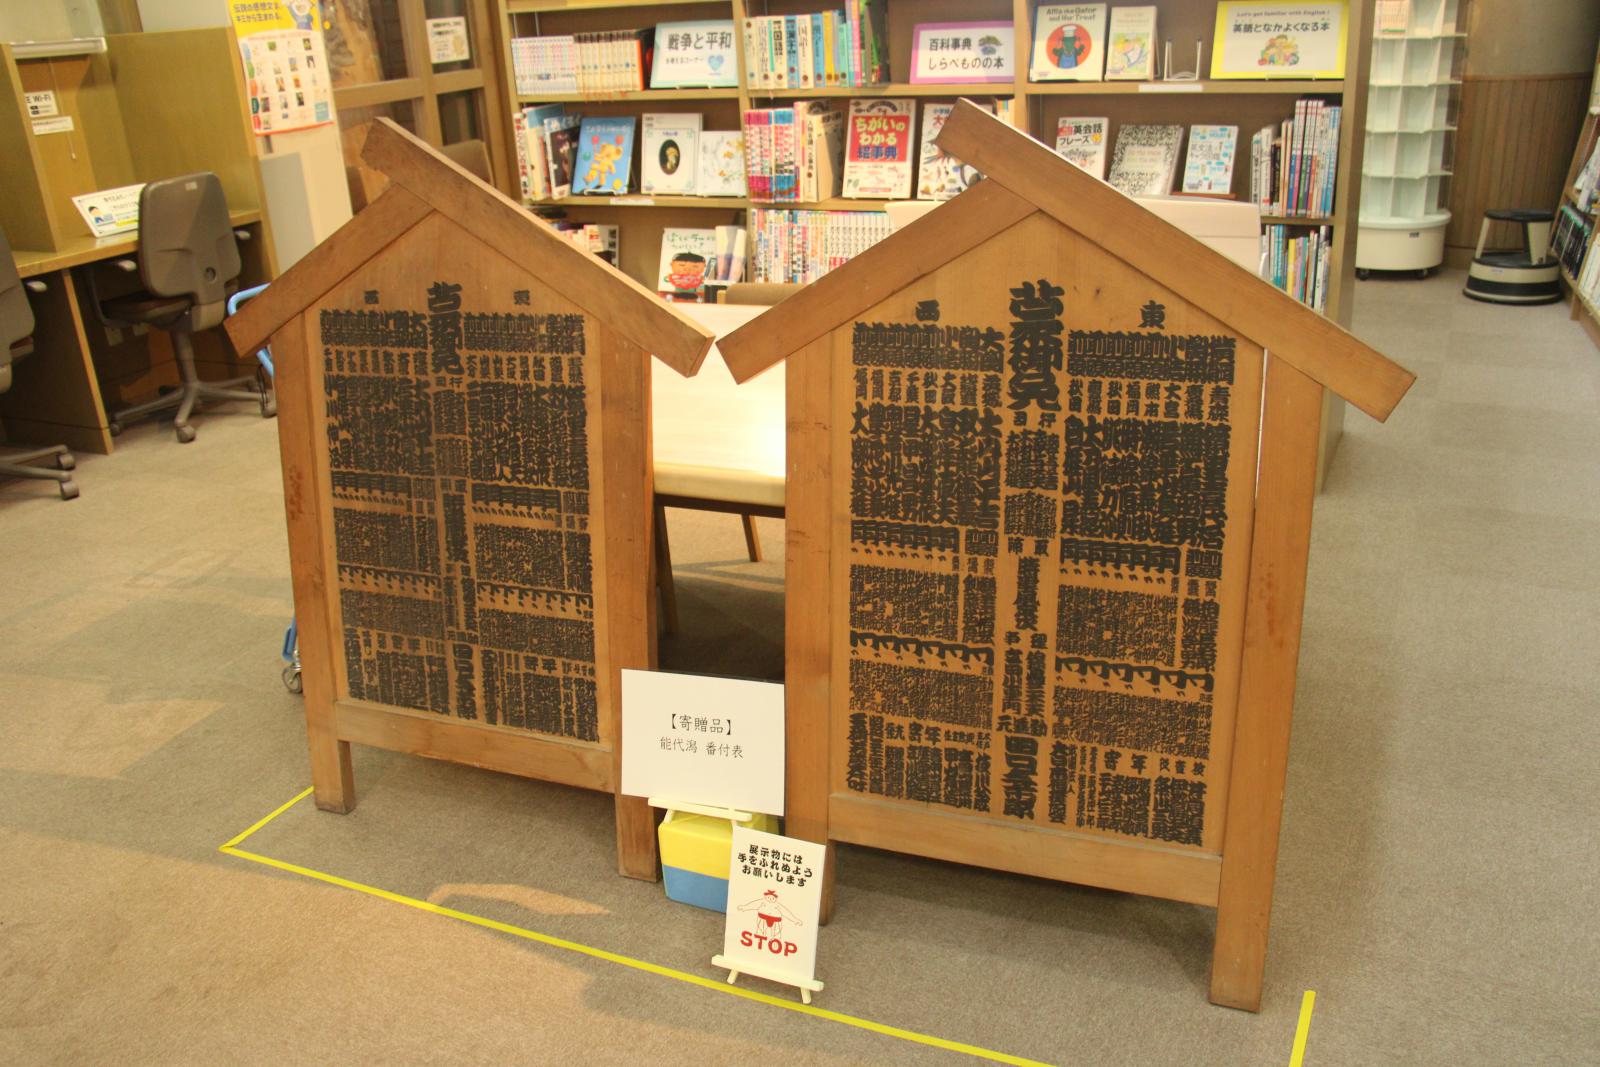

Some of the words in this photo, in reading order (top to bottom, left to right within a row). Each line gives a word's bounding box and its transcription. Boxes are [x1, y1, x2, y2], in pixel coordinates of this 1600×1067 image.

[1233, 22, 1330, 33] 英語となかよくなる本
[667, 32, 732, 50] 戦争と平和
[928, 38, 972, 51] 百科事典
[928, 57, 1004, 71] しらべものの本
[855, 117, 906, 133] ちがいの
[1073, 123, 1102, 135] 英会話
[859, 132, 897, 146] わかる
[1059, 136, 1089, 146] フレーズ
[857, 146, 897, 160] 絵事典
[1138, 300, 1166, 330] 東
[670, 713, 732, 736] 【寄贈品】
[660, 736, 698, 753] 能代潟
[705, 741, 744, 759] 番付表
[749, 843, 803, 865] 展示物には
[737, 852, 813, 879] 手をふれぬよう
[741, 864, 807, 888] お願いします
[740, 930, 798, 957] STOP
